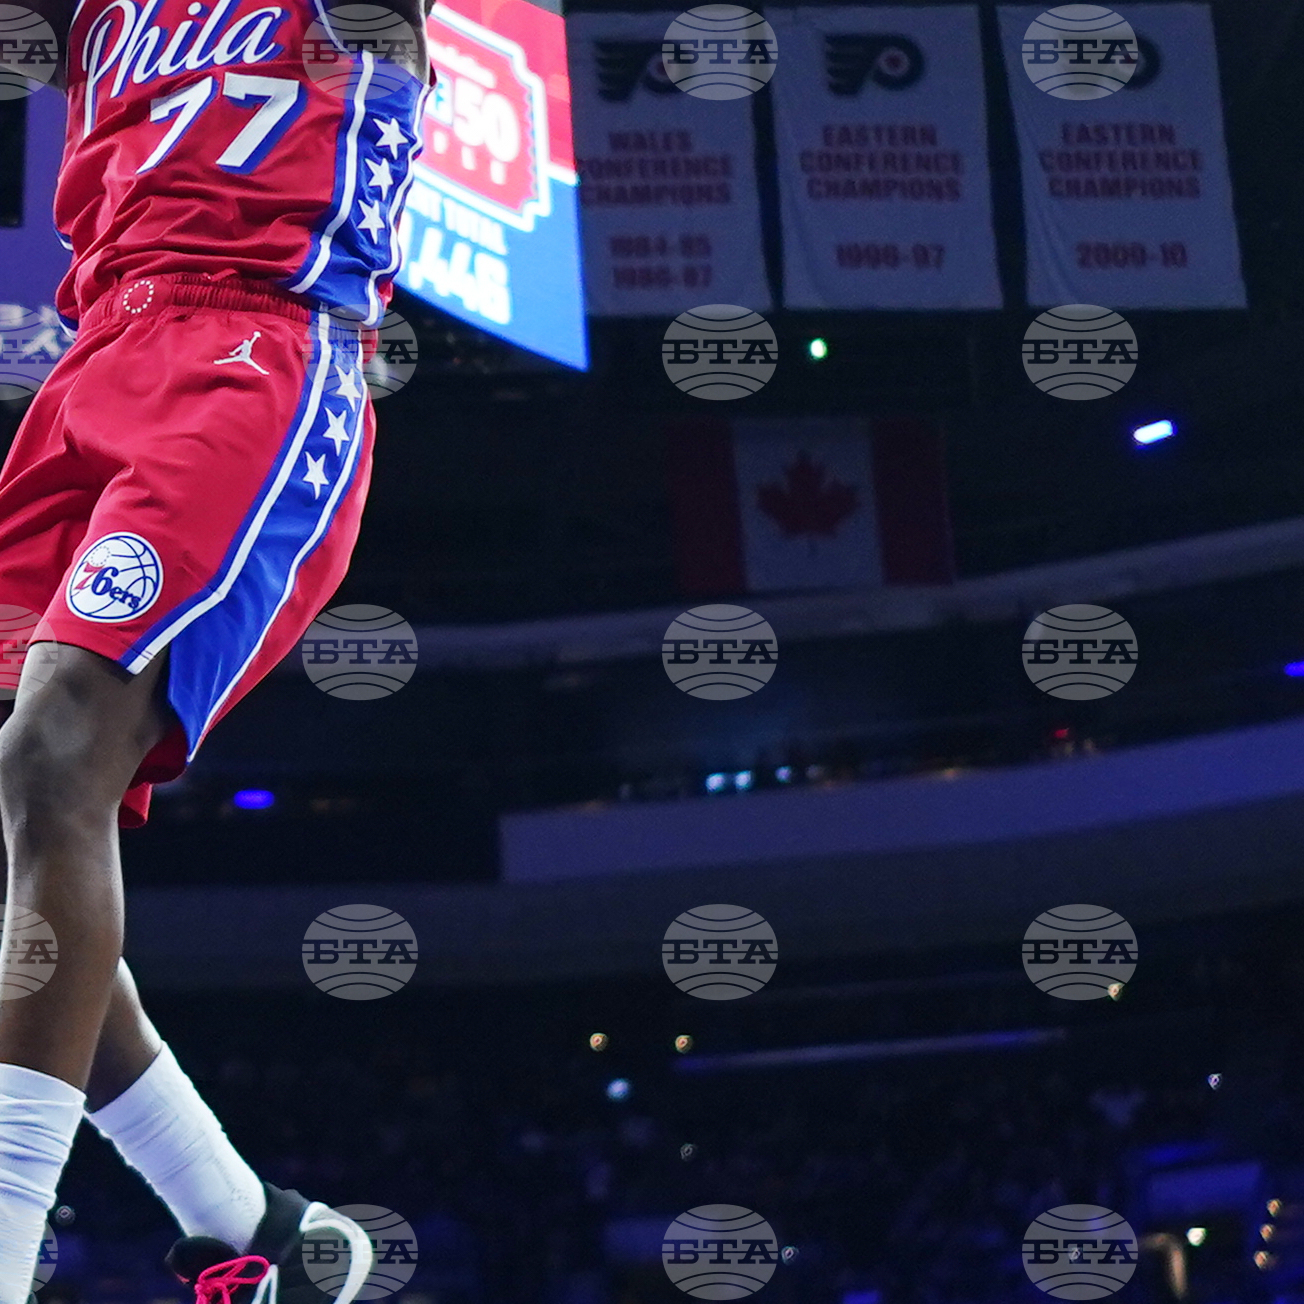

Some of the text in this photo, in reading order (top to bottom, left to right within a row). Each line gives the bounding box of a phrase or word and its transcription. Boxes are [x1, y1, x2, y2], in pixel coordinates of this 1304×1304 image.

[135, 72, 308, 176] 77
[822, 123, 938, 147] EASTERN
[1061, 122, 1176, 146] EASTERN
[799, 150, 962, 174] CONFERENCE
[1038, 149, 1202, 173] CONFERENCE
[581, 182, 732, 208] CHAMPIONS
[807, 177, 961, 201] CHAMPIONS
[1048, 176, 1201, 200] CHAMPIONS
[73, 560, 142, 609] 76ers
